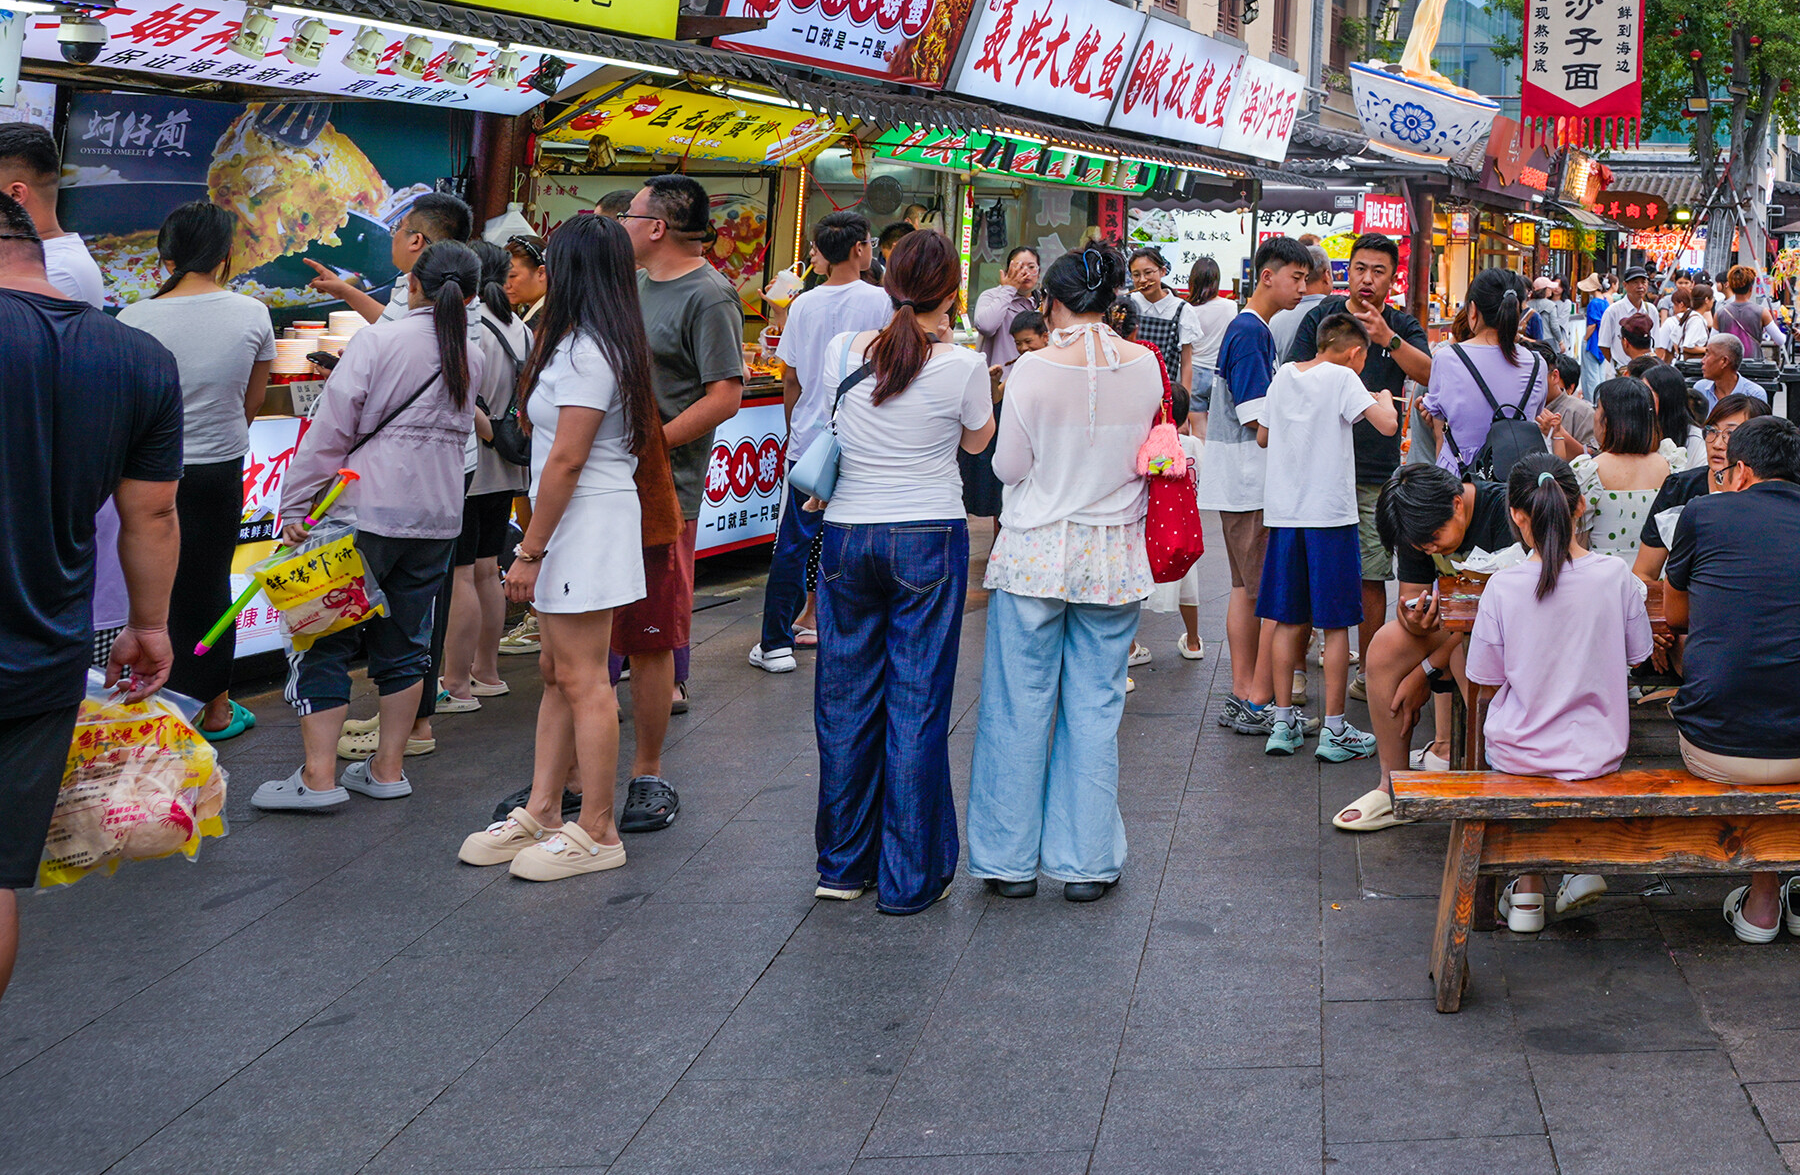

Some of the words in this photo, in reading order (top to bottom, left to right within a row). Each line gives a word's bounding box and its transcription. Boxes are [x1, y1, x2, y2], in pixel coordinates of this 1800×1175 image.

[792, 25, 888, 59] 一口就是一只蟹
[707, 447, 786, 492] 酥小螃
